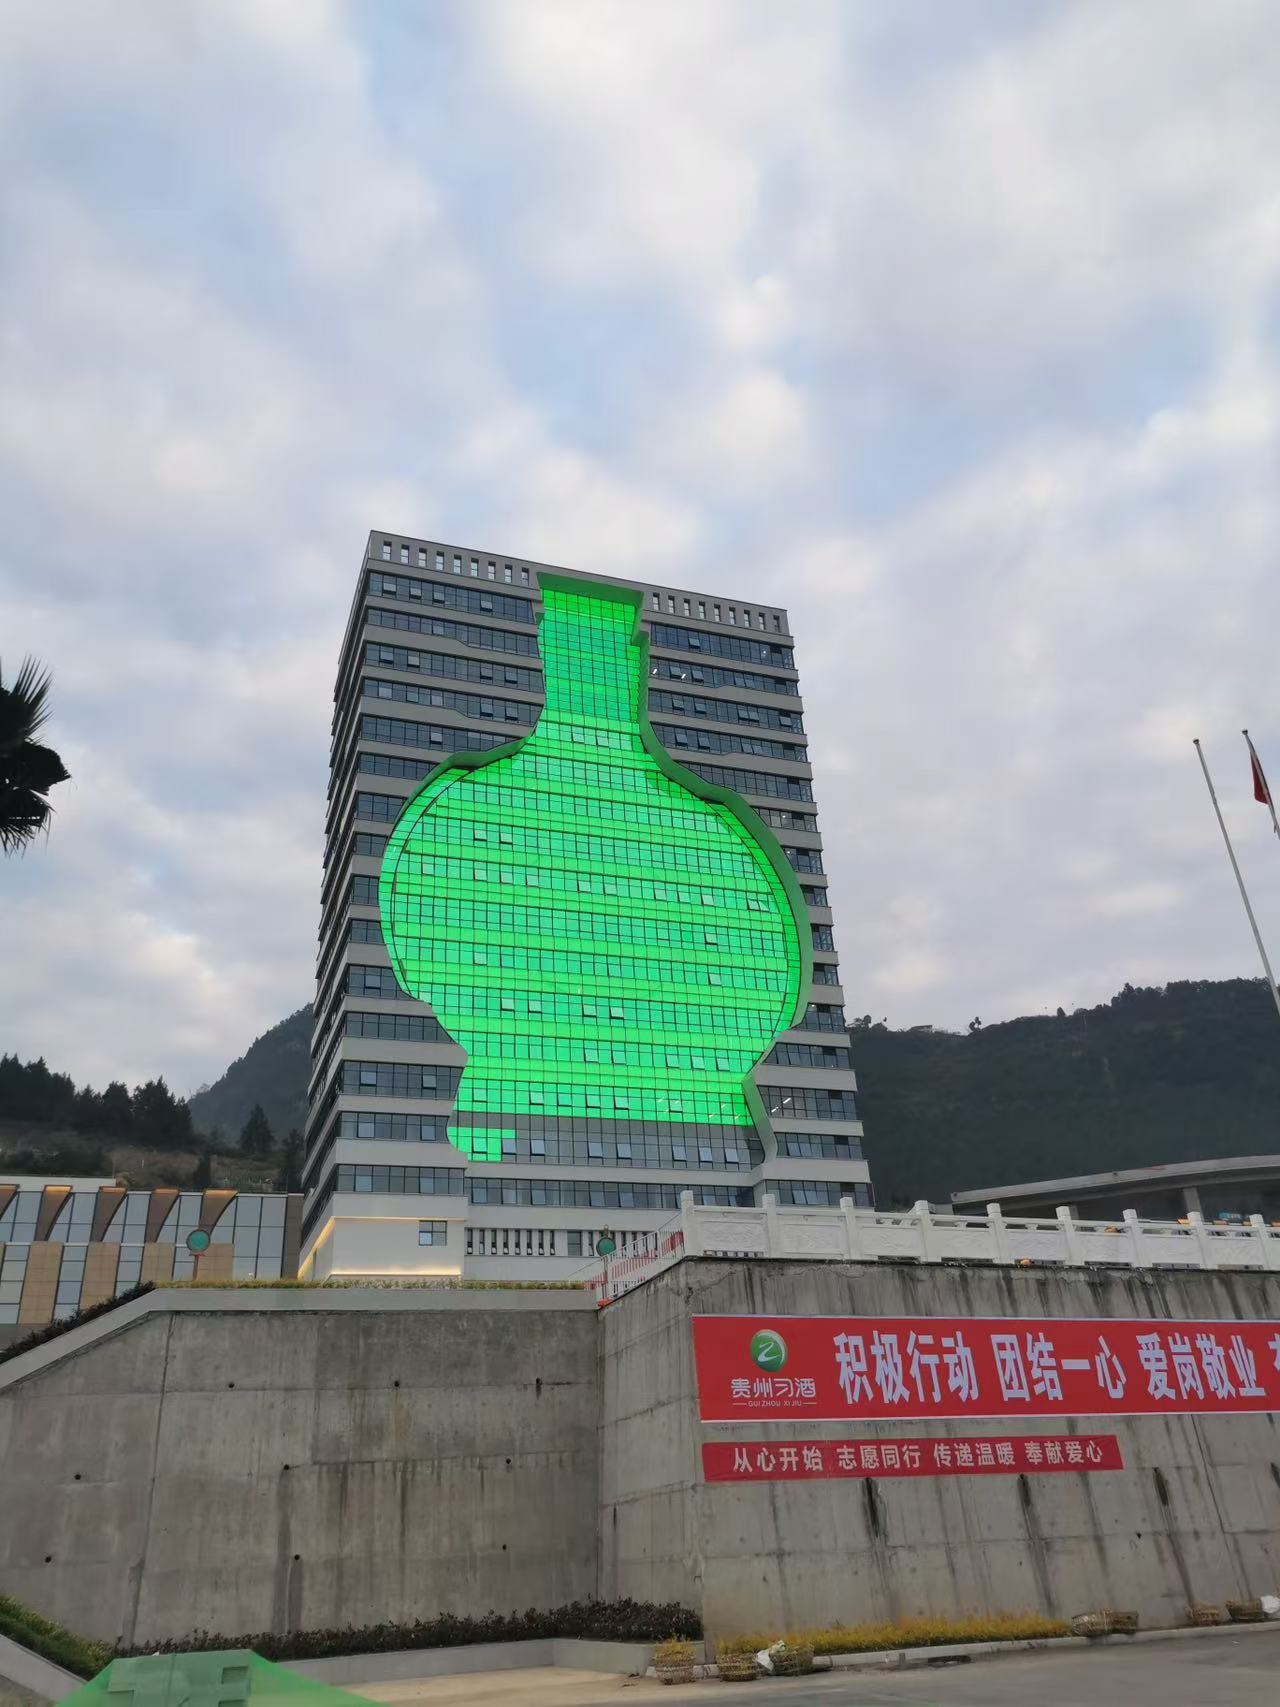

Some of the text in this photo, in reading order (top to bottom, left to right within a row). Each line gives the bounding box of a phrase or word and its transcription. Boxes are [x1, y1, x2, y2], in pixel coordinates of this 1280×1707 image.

[833, 1330, 979, 1404] 积极行动
[991, 1332, 1126, 1401] 团结一心
[1136, 1332, 1266, 1400] 爱岗敬业
[731, 1378, 816, 1398] 贵州习酒
[733, 1440, 1102, 1472] 从心开始 志愿同行 传递温暖 奉献爱心
